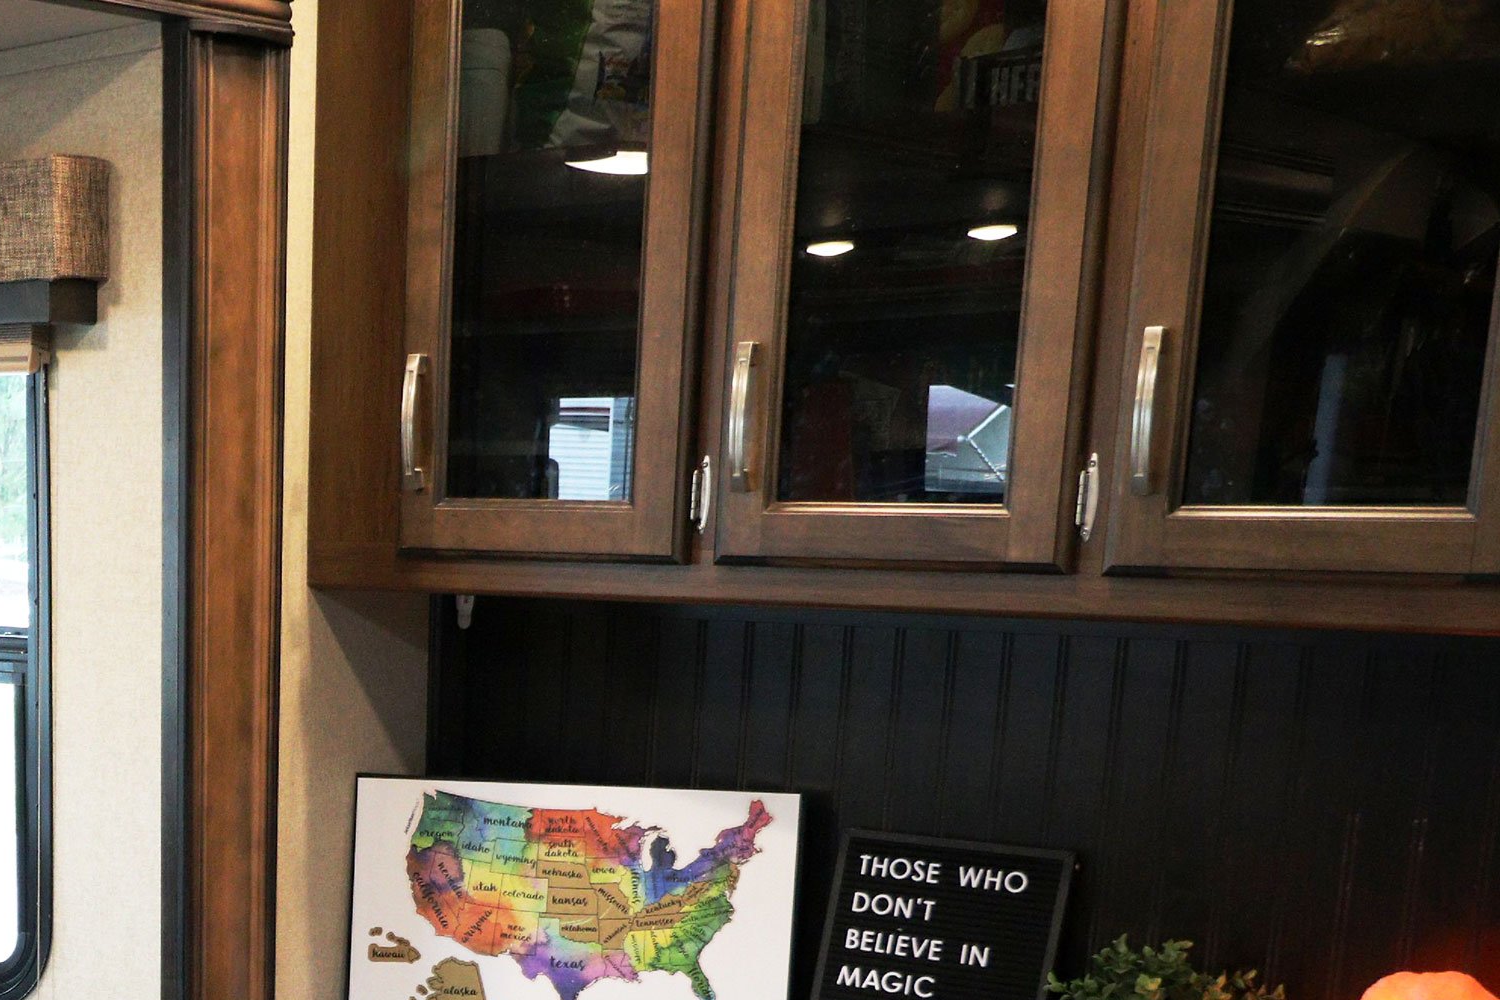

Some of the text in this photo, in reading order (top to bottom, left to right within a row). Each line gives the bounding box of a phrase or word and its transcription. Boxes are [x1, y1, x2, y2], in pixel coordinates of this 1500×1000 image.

[483, 815, 532, 829] montana
[419, 829, 453, 841] oregon
[461, 841, 490, 854] idaho
[548, 839, 575, 849] south
[545, 849, 578, 857] dakota
[495, 853, 538, 868] wyoming
[541, 867, 583, 879] nebraska
[591, 866, 616, 874] iowa
[859, 854, 1028, 893] THOSE WHO
[437, 862, 463, 899] nevada
[472, 881, 498, 893] utah
[631, 868, 640, 904] illinois
[413, 872, 449, 929] california
[502, 889, 545, 901] colorado
[551, 896, 588, 907] kansas
[597, 888, 629, 914] missouri
[645, 899, 682, 914] kentucky
[851, 891, 936, 921] DON'T
[461, 910, 493, 943] arizona
[507, 923, 526, 931] new
[561, 925, 598, 933] oklahoma
[635, 918, 674, 928] tennessee
[499, 933, 532, 942] mexico
[845, 929, 990, 968] BELIEVE IN
[550, 955, 586, 971] texas
[836, 966, 936, 998] MAGIC
[444, 986, 478, 996] alaska
